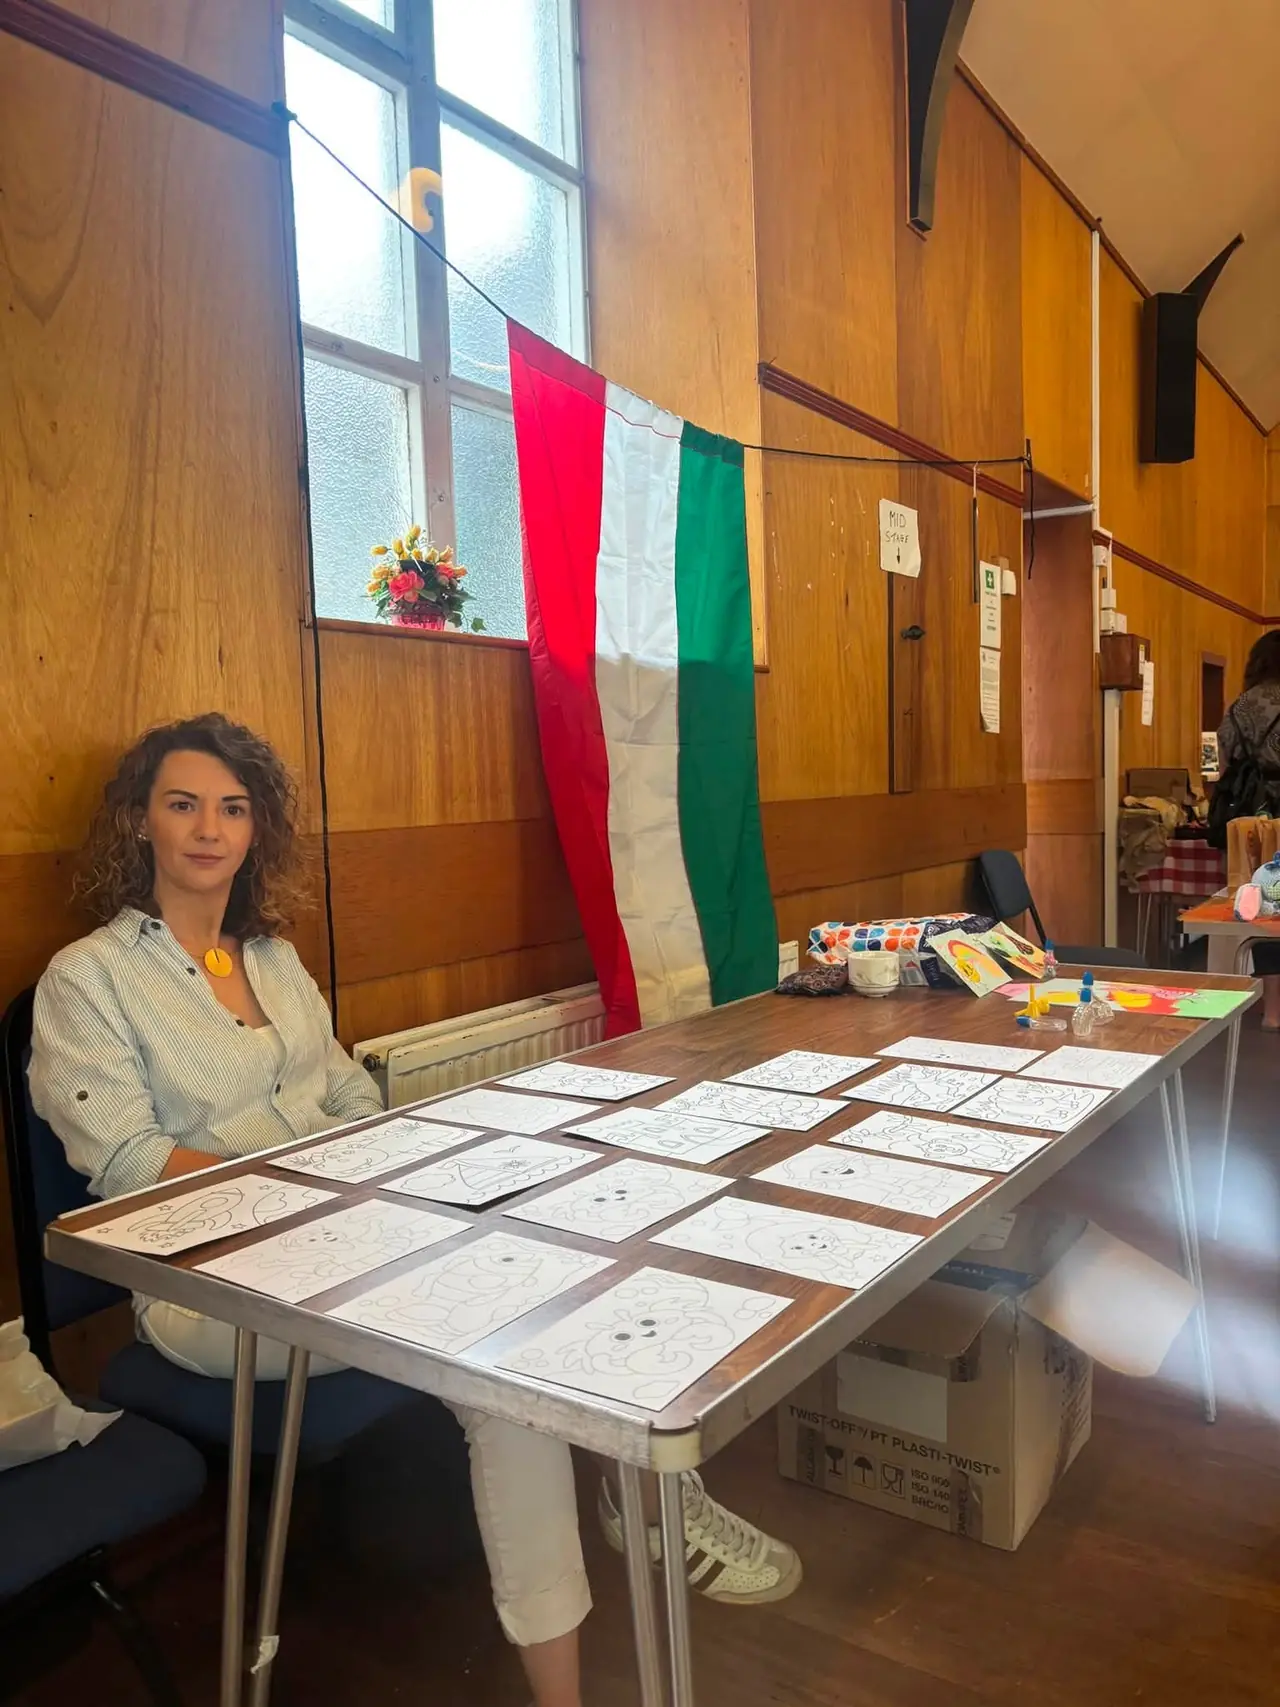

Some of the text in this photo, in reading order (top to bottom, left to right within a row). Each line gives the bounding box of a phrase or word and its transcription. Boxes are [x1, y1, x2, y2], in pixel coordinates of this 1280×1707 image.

[889, 510, 907, 528] MID
[870, 1430, 888, 1445] PT
[911, 1466, 929, 1481] ISO
[911, 1481, 929, 1495] ISO
